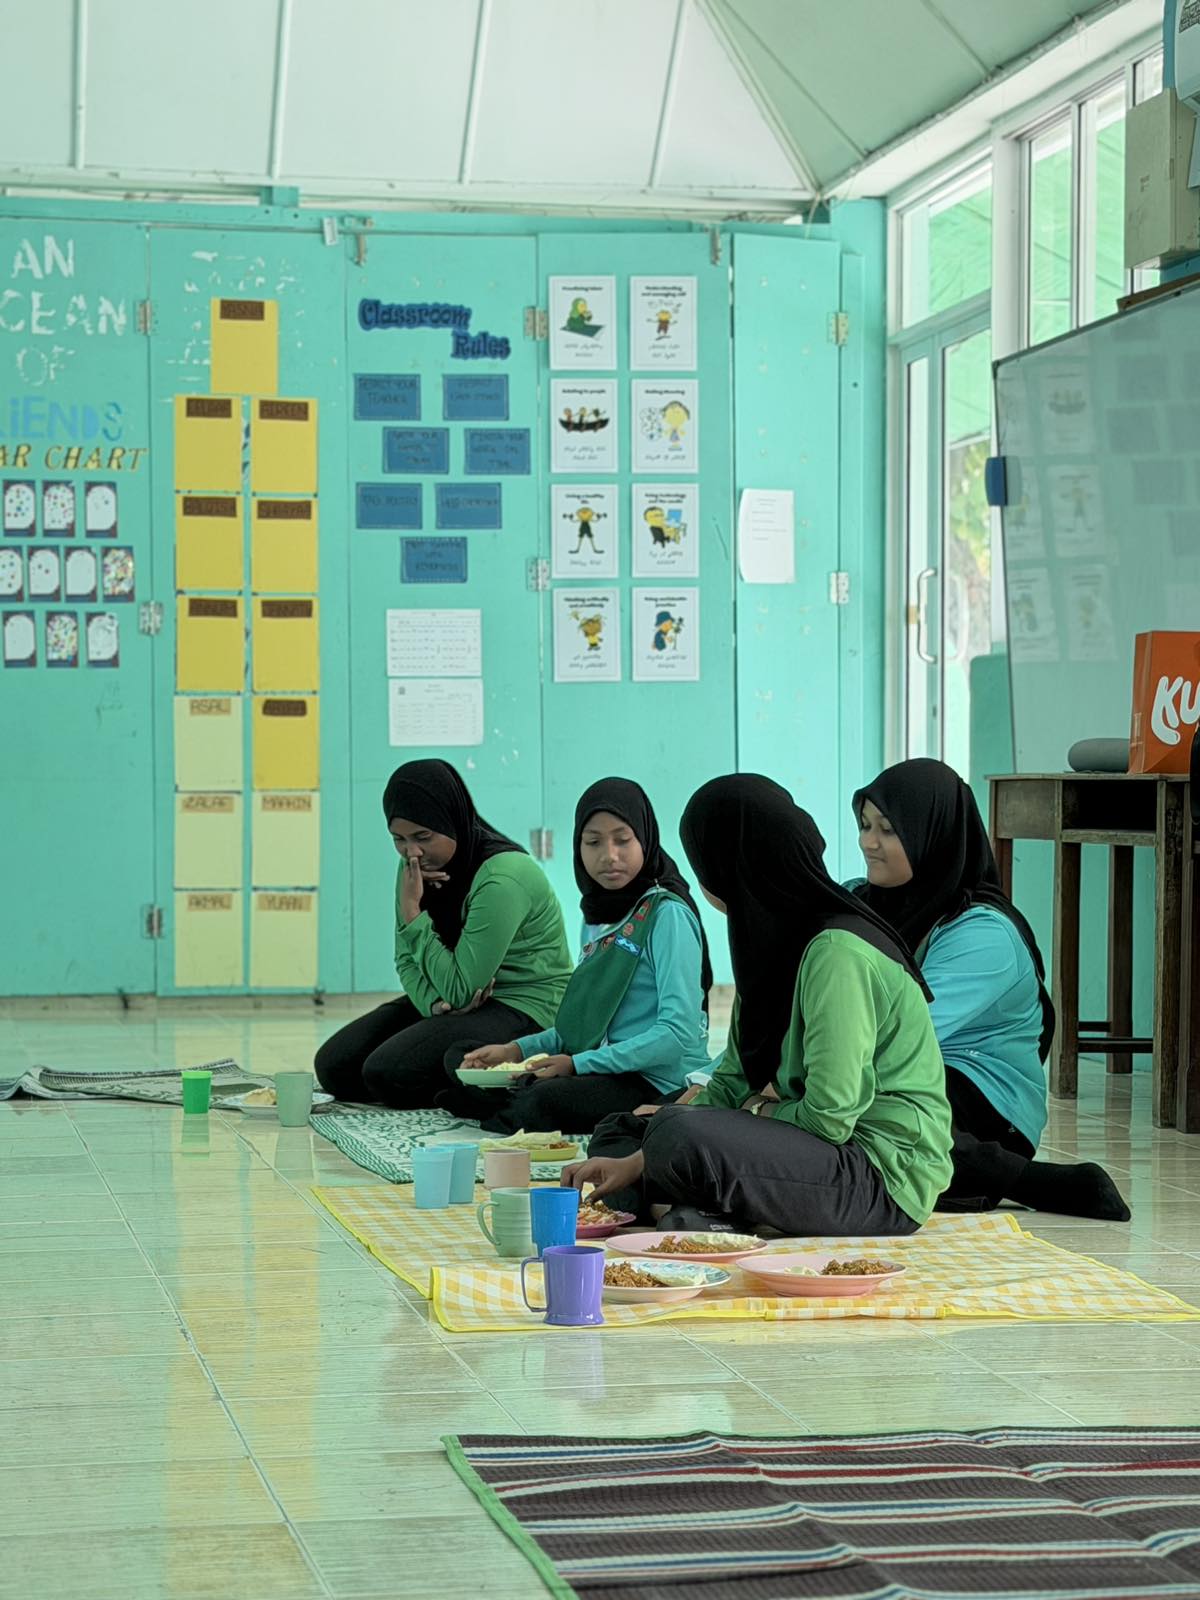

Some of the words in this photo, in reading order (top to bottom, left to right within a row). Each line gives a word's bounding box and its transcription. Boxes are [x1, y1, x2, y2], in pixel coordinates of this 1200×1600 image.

[11, 235, 75, 279] AN
[358, 299, 472, 331] Classroom
[451, 331, 511, 360] Rules
[44, 445, 149, 471] CHART
